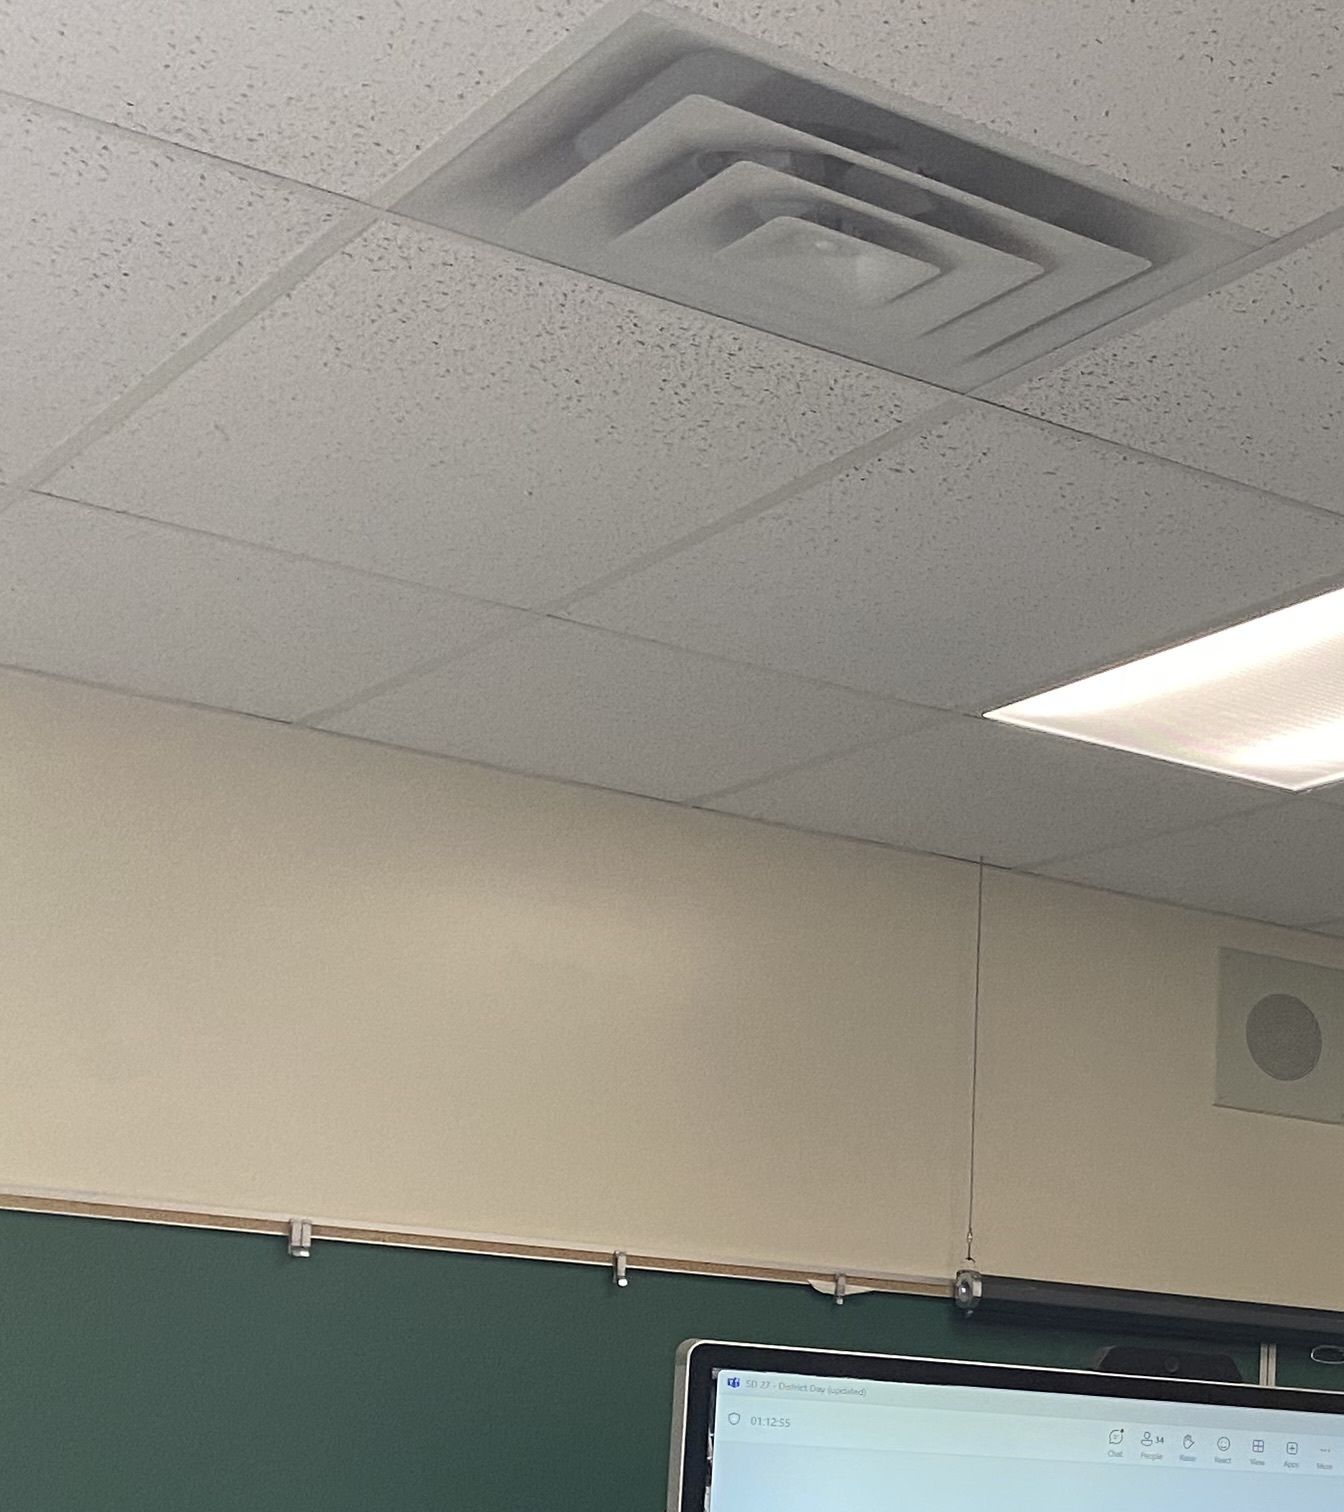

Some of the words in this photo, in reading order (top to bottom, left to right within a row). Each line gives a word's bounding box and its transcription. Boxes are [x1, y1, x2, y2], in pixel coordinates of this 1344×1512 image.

[745, 1380, 757, 1388] SD
[760, 1380, 770, 1389] 27
[779, 1382, 808, 1392] District
[810, 1384, 825, 1394] Day
[828, 1386, 867, 1397] (updated)
[750, 1416, 791, 1428] 01:12:55
[1155, 1435, 1164, 1444] 34
[1107, 1449, 1123, 1458] Chat
[1140, 1452, 1163, 1461] People
[1214, 1456, 1232, 1464] React
[1249, 1458, 1265, 1466] View
[1283, 1460, 1299, 1469] Apps
[1316, 1462, 1333, 1470] More
